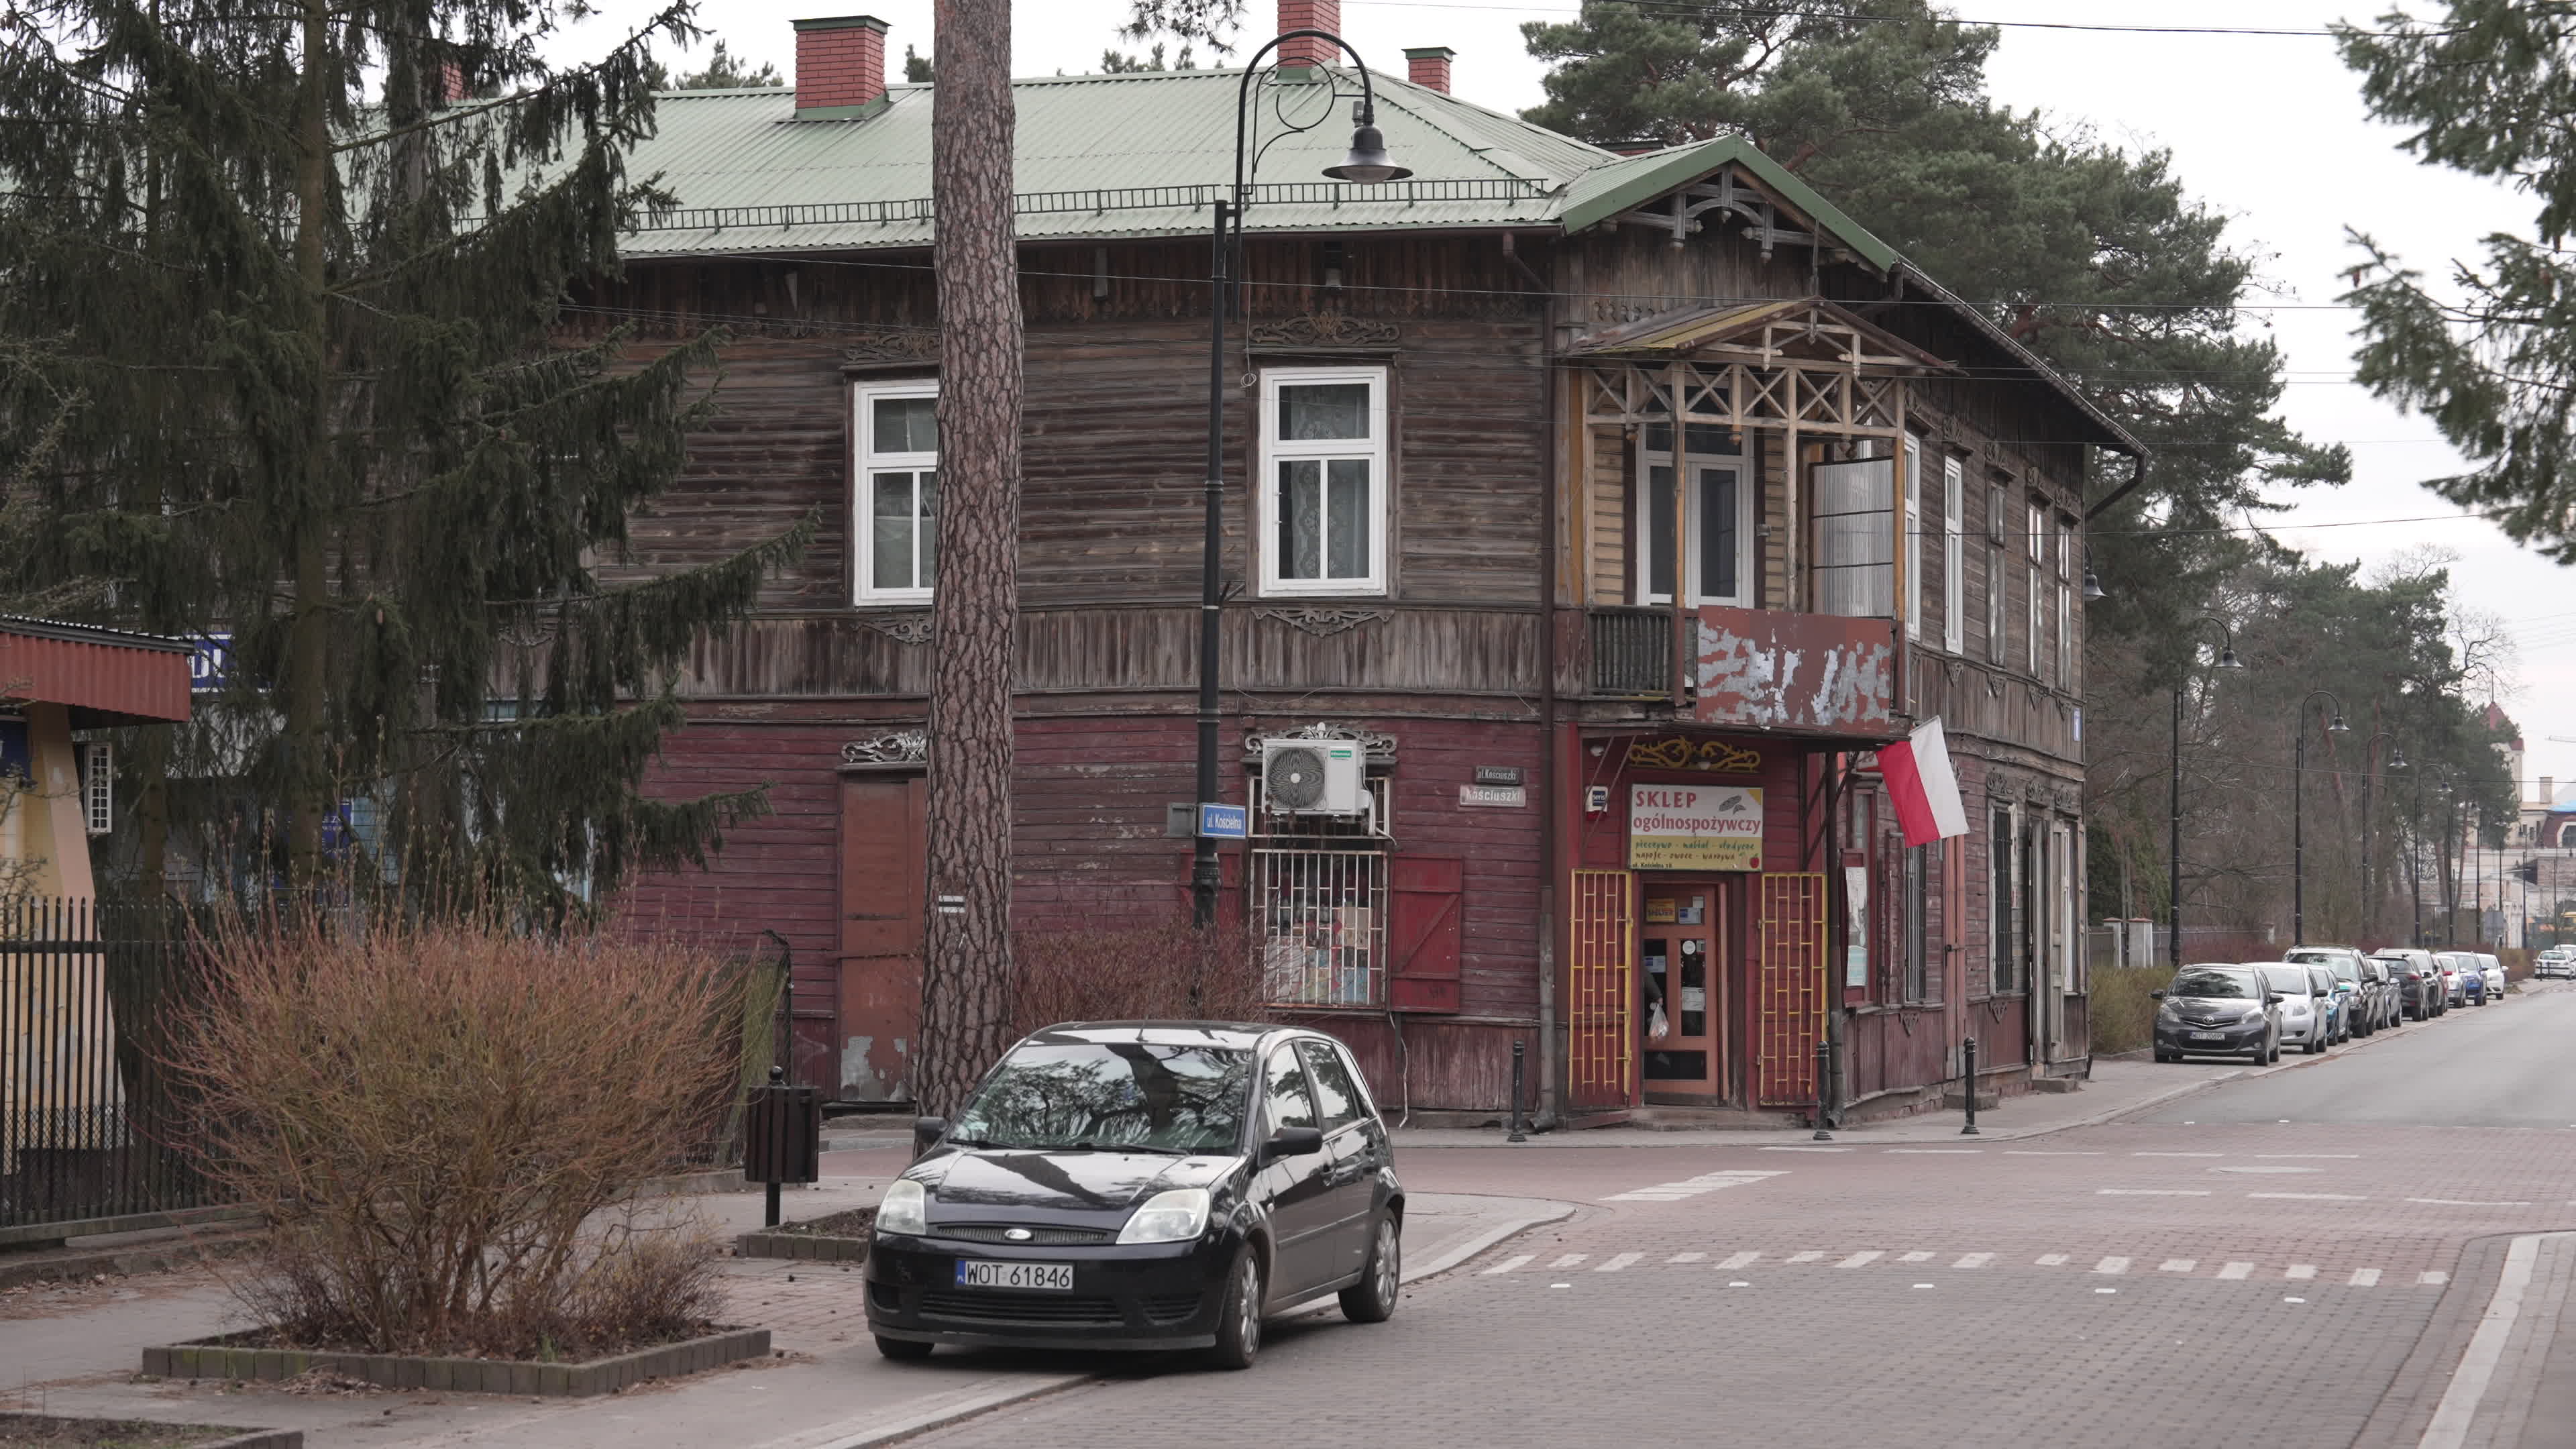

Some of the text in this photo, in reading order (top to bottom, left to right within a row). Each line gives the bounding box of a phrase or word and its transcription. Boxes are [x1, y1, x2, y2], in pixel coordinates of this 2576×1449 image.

[1635, 790, 1697, 808] SKLEP
[1215, 812, 1242, 830] Kościelna
[1633, 812, 1761, 835] ogólnospożywczy
[967, 1263, 1070, 1288] WOT 61846
